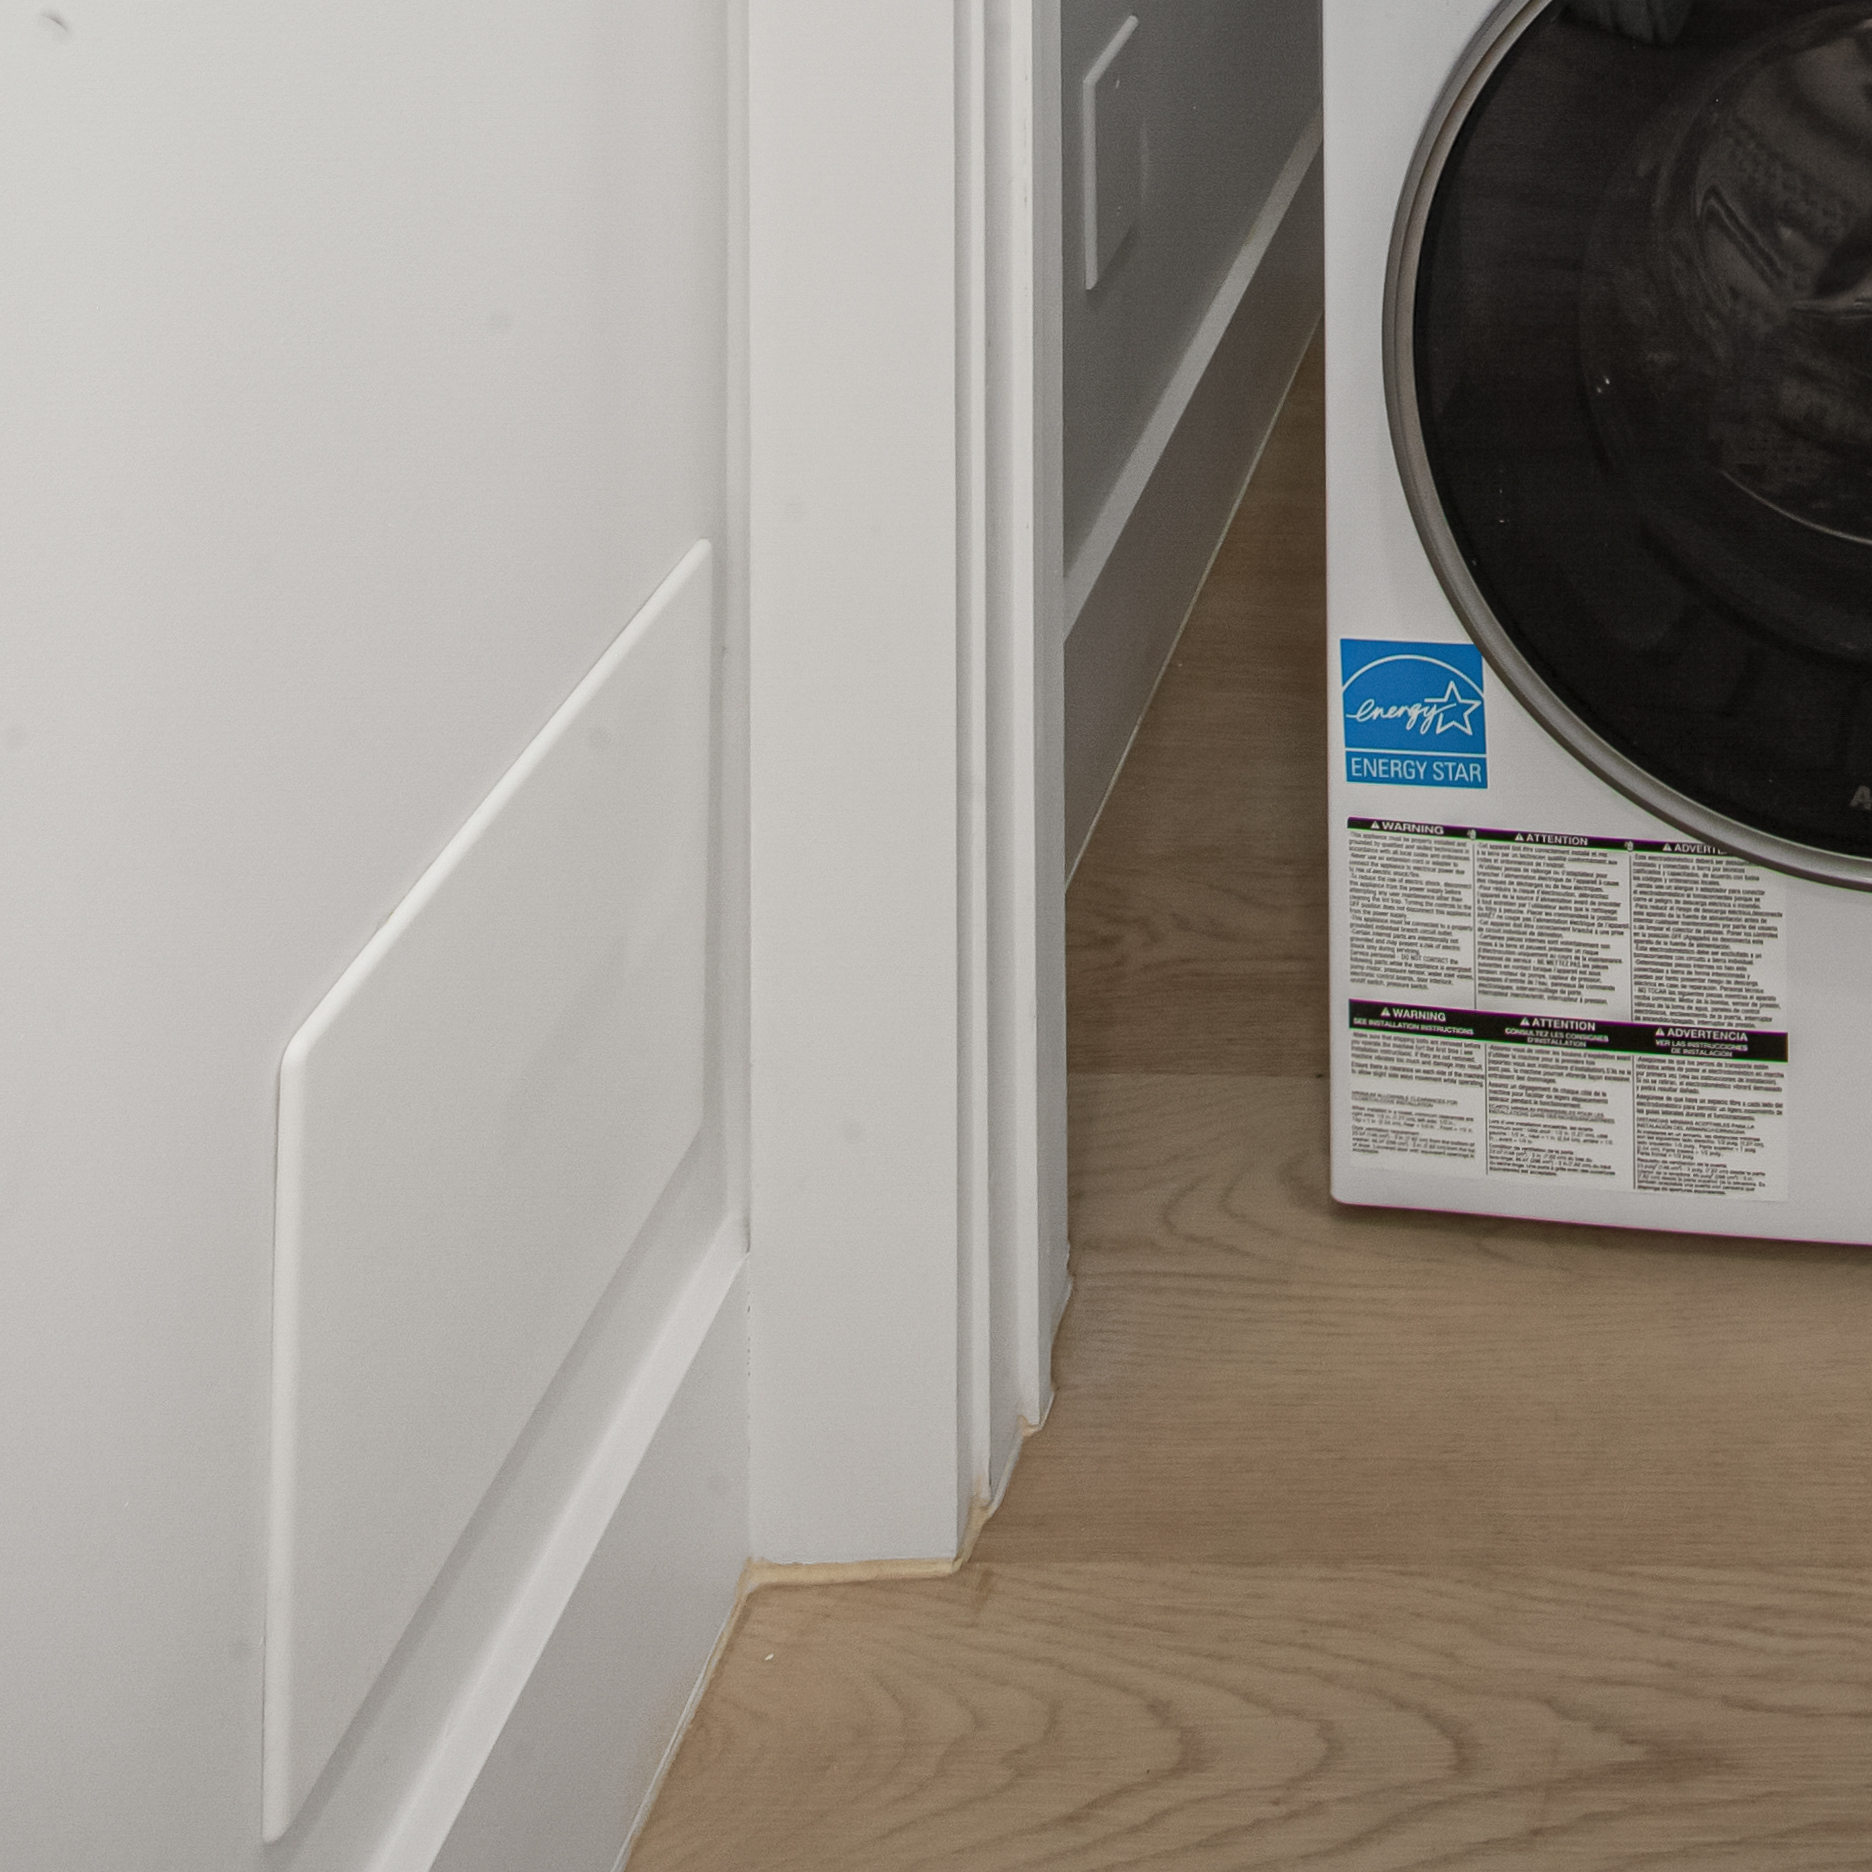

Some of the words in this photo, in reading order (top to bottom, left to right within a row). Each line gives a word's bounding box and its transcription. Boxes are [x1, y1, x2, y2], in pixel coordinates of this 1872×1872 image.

[1346, 699, 1446, 734] energy
[1351, 758, 1425, 780] ENERGY
[1432, 760, 1482, 782] STAR
[1381, 821, 1444, 835] WARNING
[1526, 833, 1588, 846] ATTENTION
[1393, 1008, 1447, 1022] WARNING
[1368, 1019, 1420, 1031] INSTALLATION
[1532, 1018, 1596, 1032] ATTENTION
[1667, 1028, 1749, 1042] ADVERTENCIA
[1671, 1039, 1686, 1048] LAS
